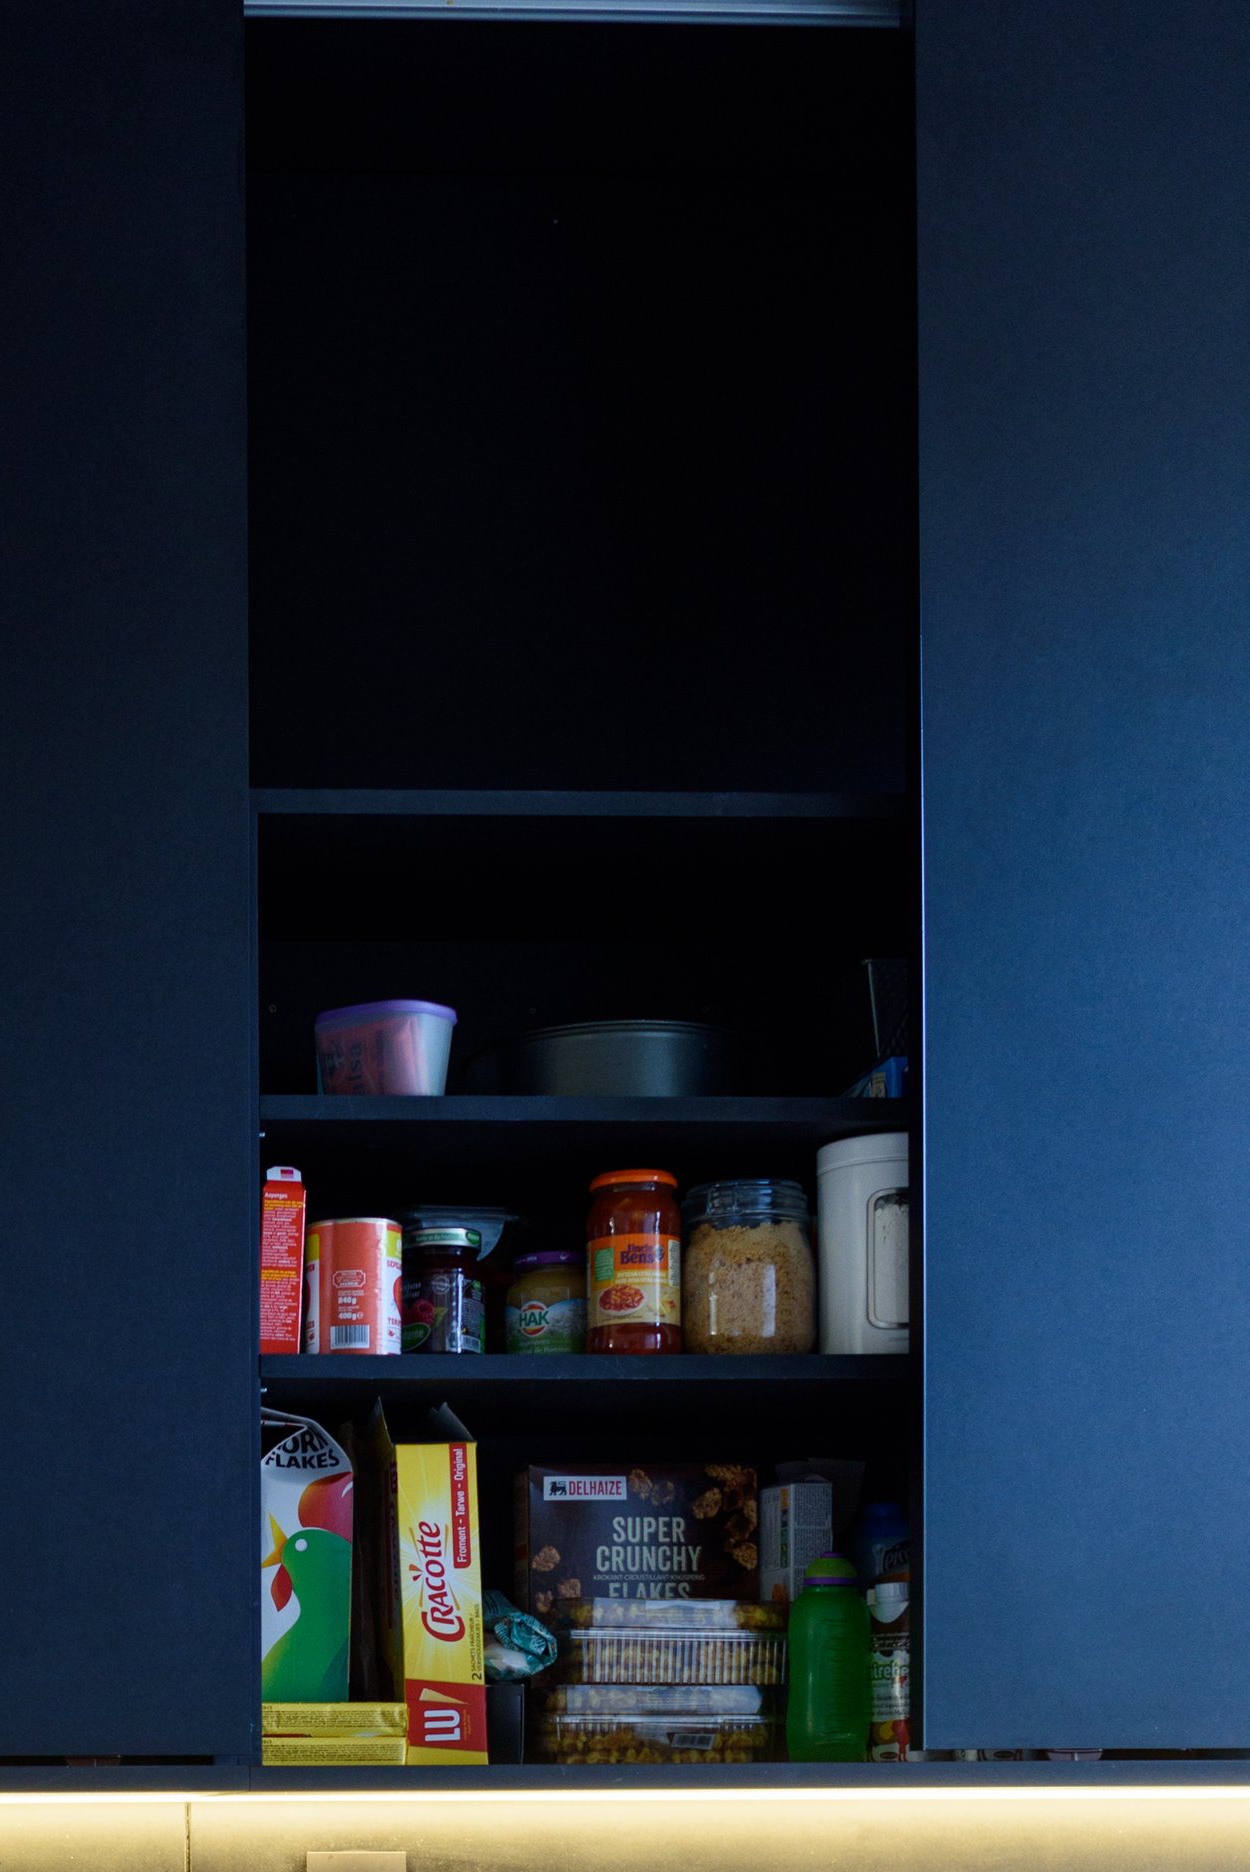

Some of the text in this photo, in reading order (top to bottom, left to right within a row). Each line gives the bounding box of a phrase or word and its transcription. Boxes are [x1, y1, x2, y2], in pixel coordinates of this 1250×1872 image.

[519, 1310, 550, 1327] HAK
[265, 1449, 340, 1469] FLAKES
[453, 1448, 466, 1481] Original
[568, 1480, 622, 1496] DELHAIZE
[455, 1491, 466, 1517] Tarwe
[612, 1516, 686, 1543] SUPER
[457, 1526, 467, 1563] Froment
[596, 1544, 702, 1573] CRUNCHY
[608, 1582, 691, 1600] FLAKES
[471, 1672, 482, 1681] 2
[424, 1709, 461, 1742] LU
